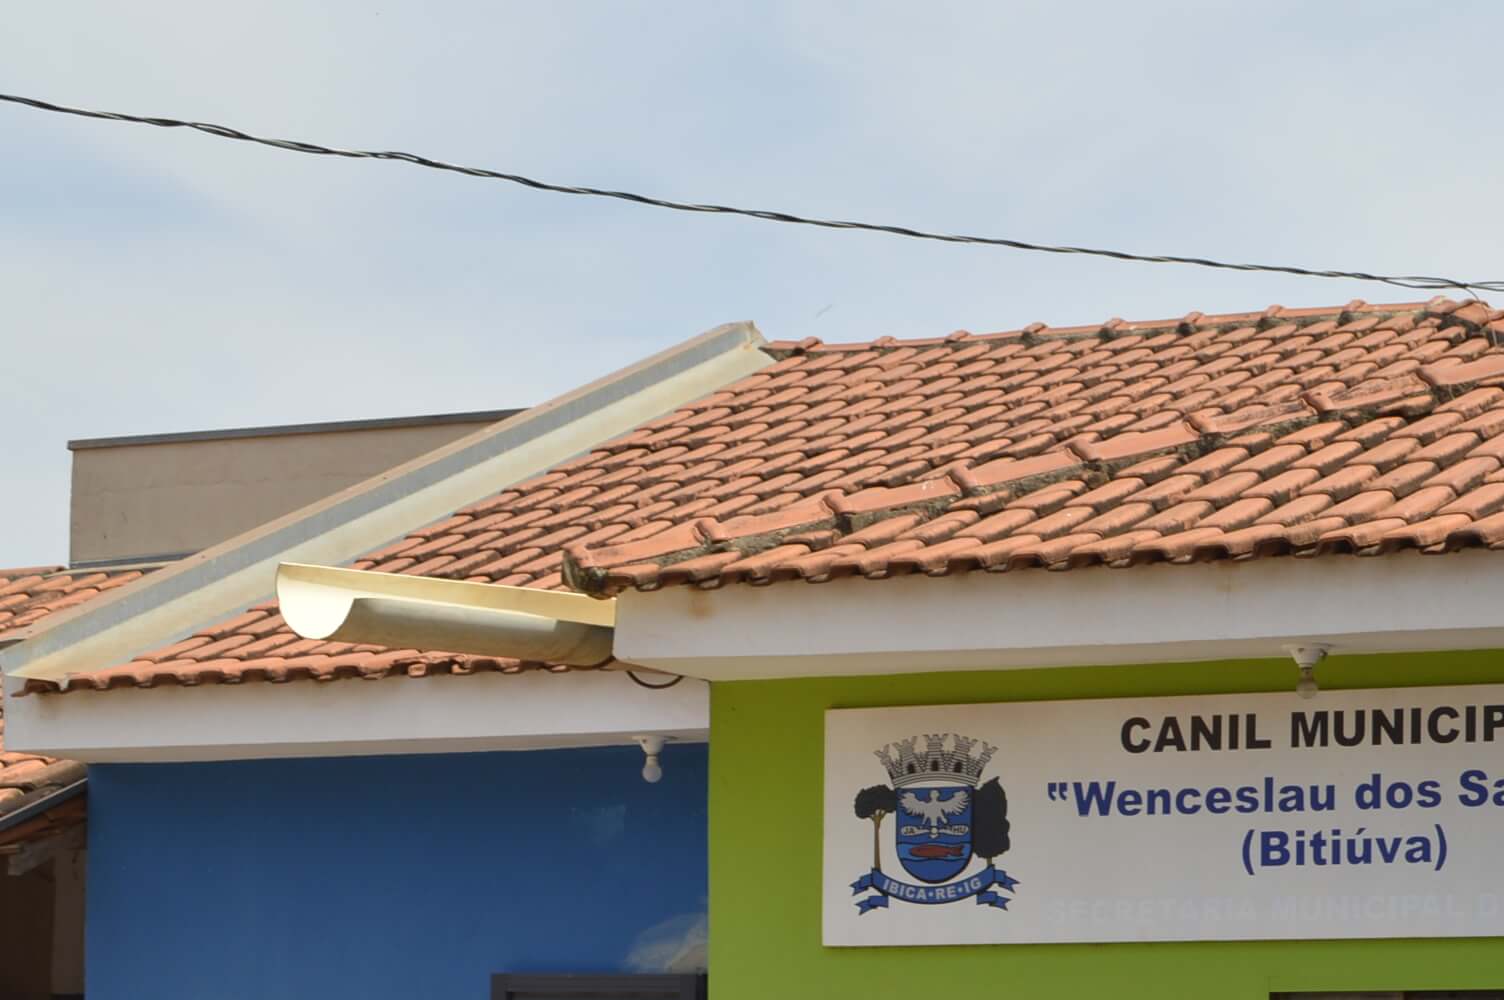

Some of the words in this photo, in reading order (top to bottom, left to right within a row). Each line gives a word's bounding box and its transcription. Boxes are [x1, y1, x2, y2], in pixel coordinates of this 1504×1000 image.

[1120, 713, 1272, 754] CANIL
[1047, 776, 1336, 817] “Wenceslau
[1354, 773, 1442, 812] dos
[1242, 823, 1447, 876] (Bitiúva)
[1271, 893, 1463, 922] MUNICIPAL
